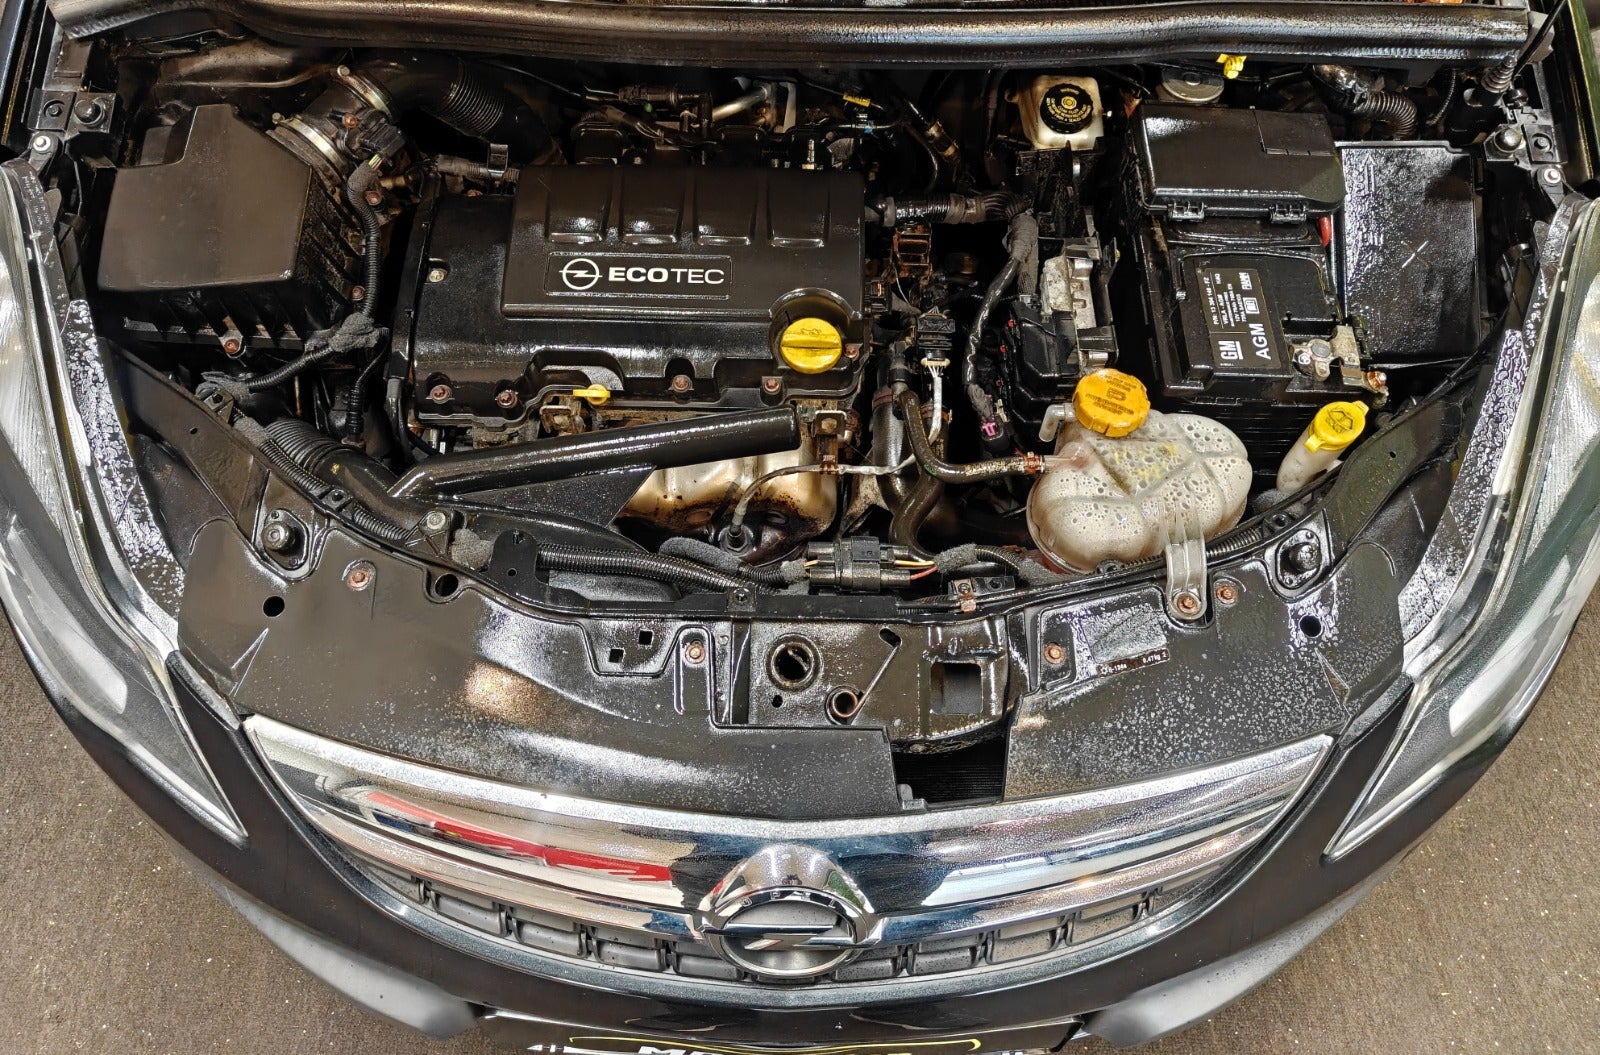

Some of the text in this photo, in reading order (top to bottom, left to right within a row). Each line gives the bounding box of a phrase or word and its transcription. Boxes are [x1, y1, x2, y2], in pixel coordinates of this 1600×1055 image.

[608, 267, 725, 285] ECOTEC
[1218, 341, 1238, 360] GM
[1249, 324, 1271, 360] AGM
